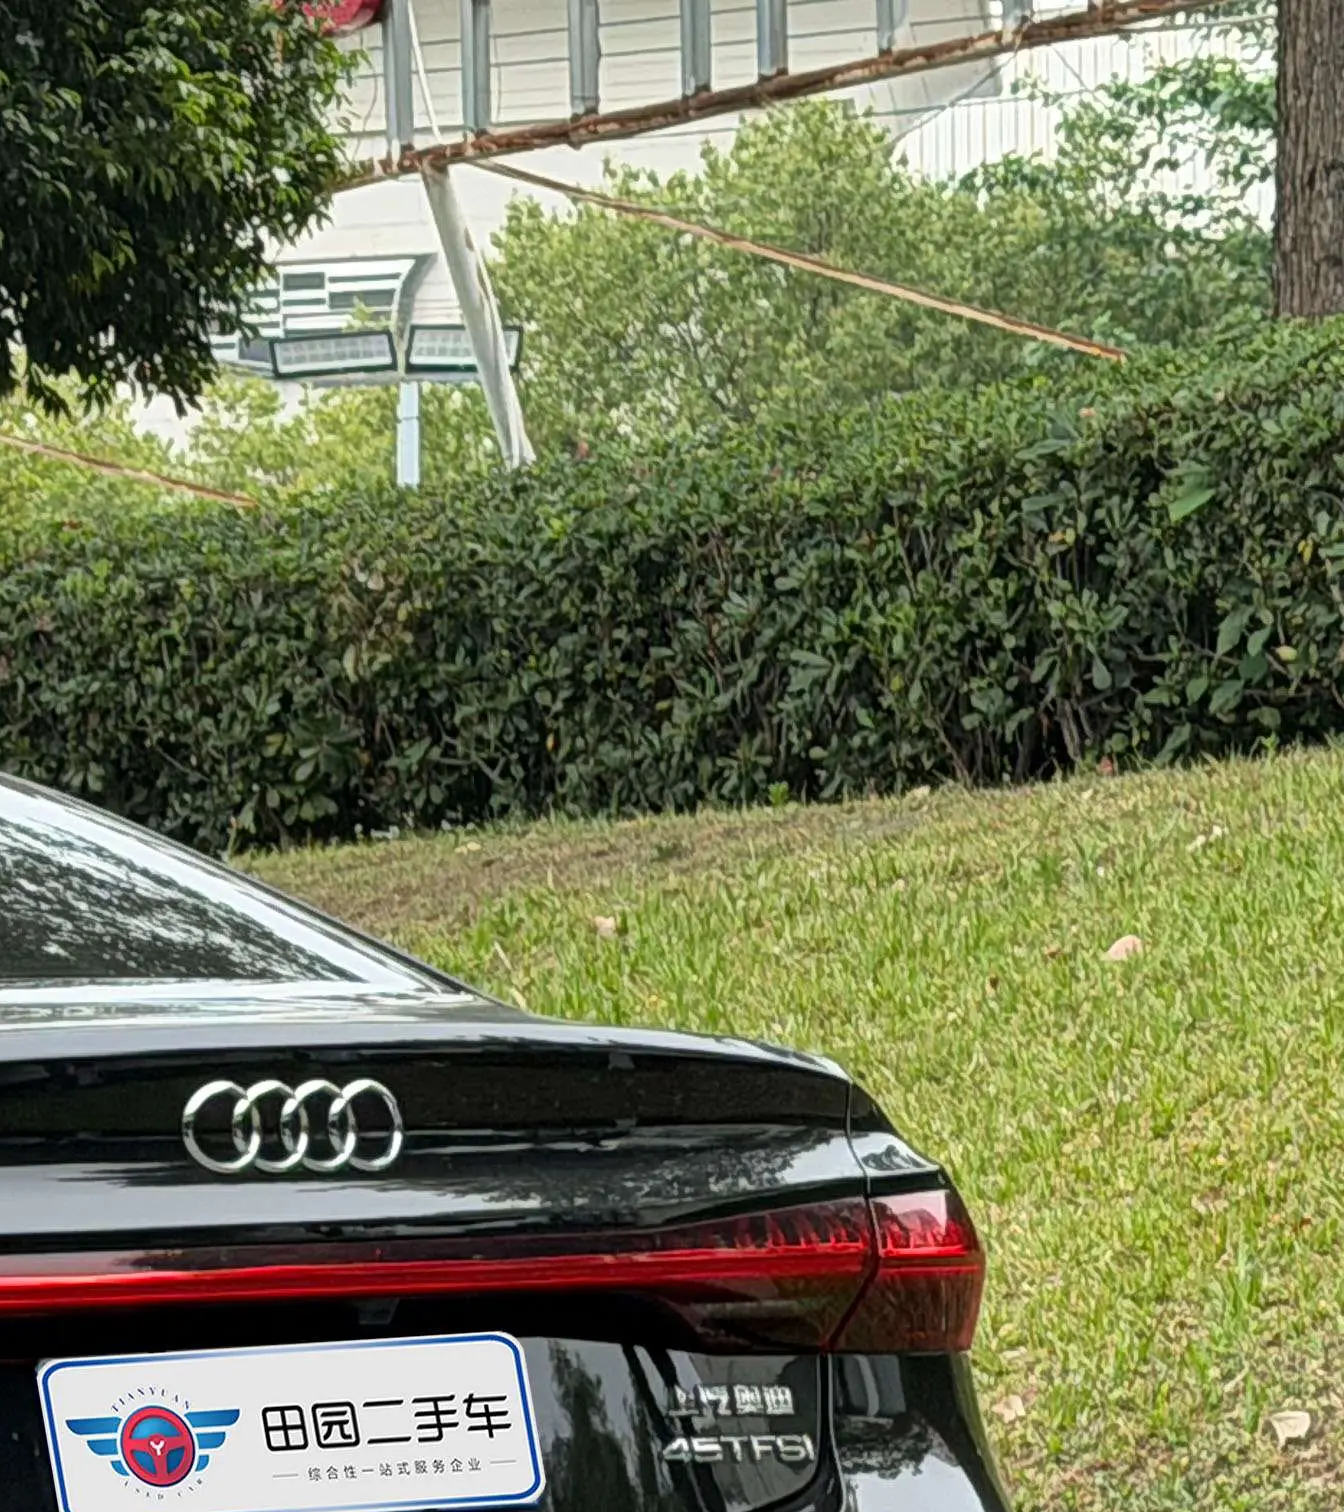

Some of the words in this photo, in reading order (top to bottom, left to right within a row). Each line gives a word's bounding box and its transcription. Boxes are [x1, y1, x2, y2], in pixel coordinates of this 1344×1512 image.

[262, 1393, 512, 1452] 田园二手车
[308, 1458, 482, 1482] 综合性一站式服务企业
